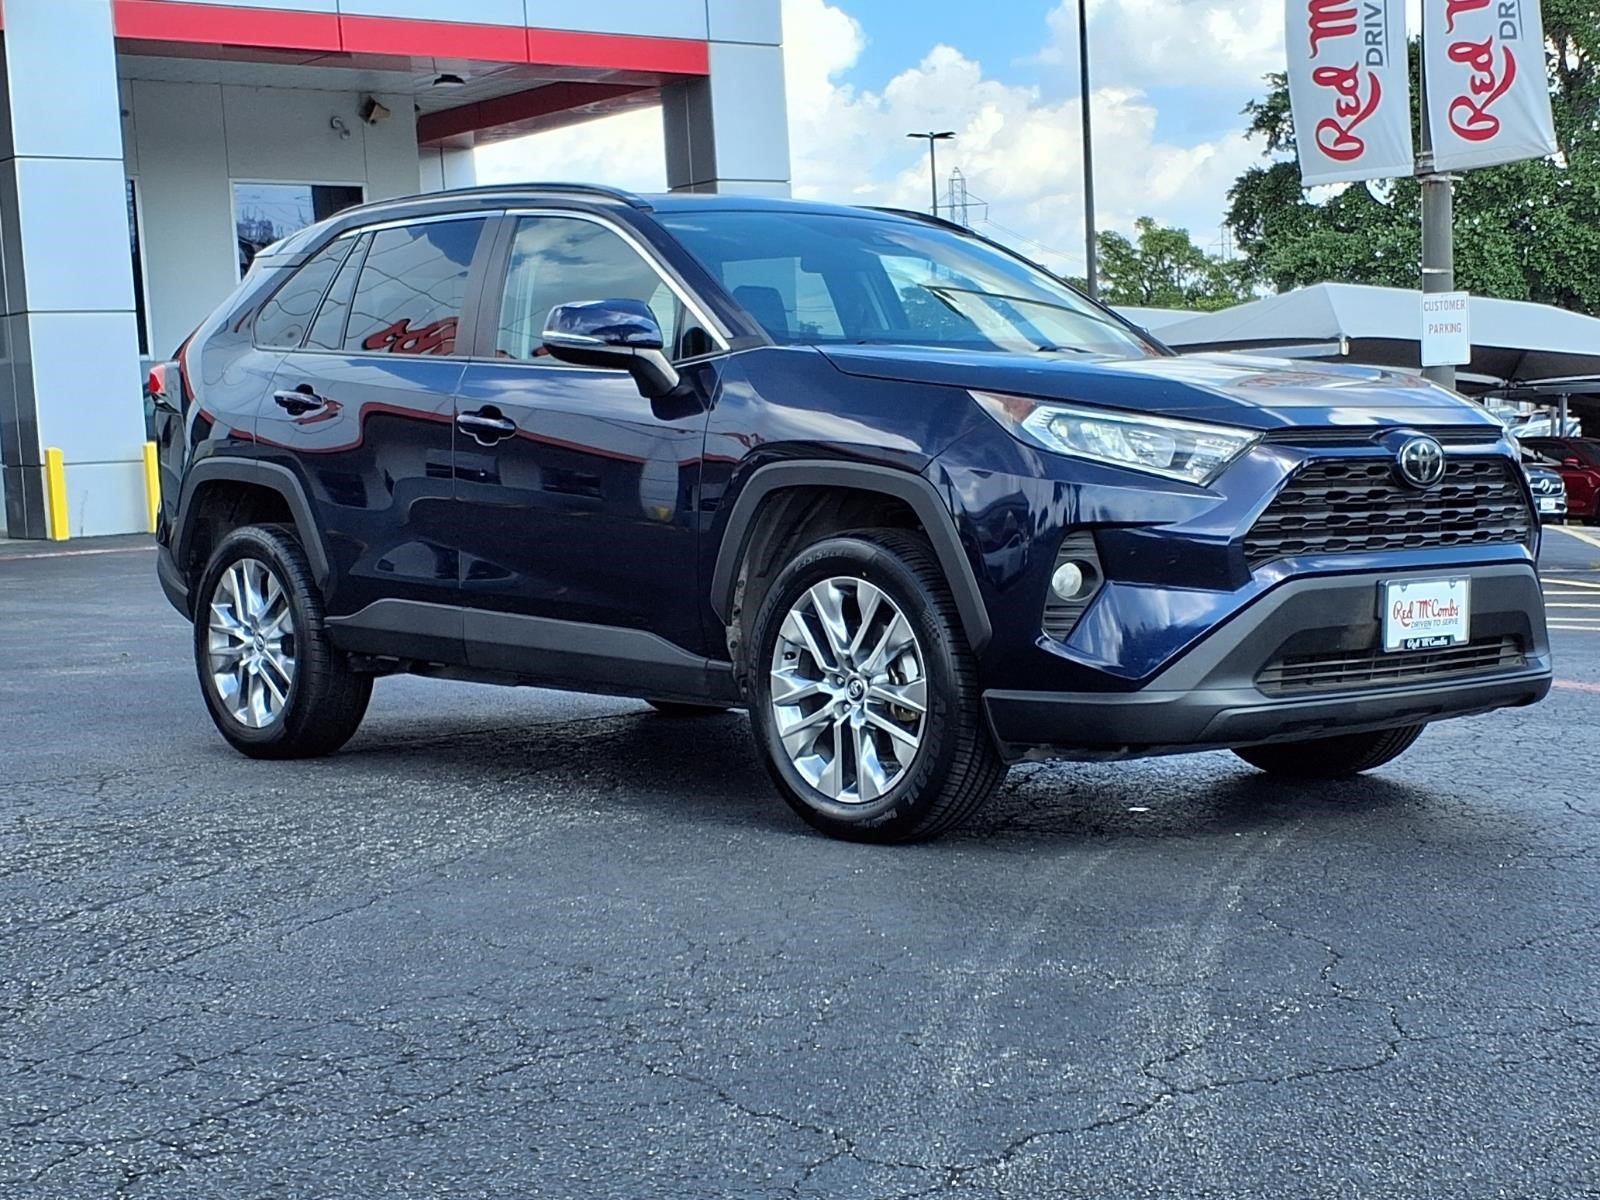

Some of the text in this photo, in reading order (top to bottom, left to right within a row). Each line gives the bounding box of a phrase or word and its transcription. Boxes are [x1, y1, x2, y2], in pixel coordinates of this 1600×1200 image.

[1364, 2, 1384, 66] DRIV
[1498, 0, 1518, 39] DR
[1448, 35, 1516, 141] Red
[1313, 61, 1381, 161] Red
[1423, 299, 1466, 312] CUSTOMER
[1428, 322, 1462, 334] PARKING
[1393, 598, 1459, 627] Red McCombs
